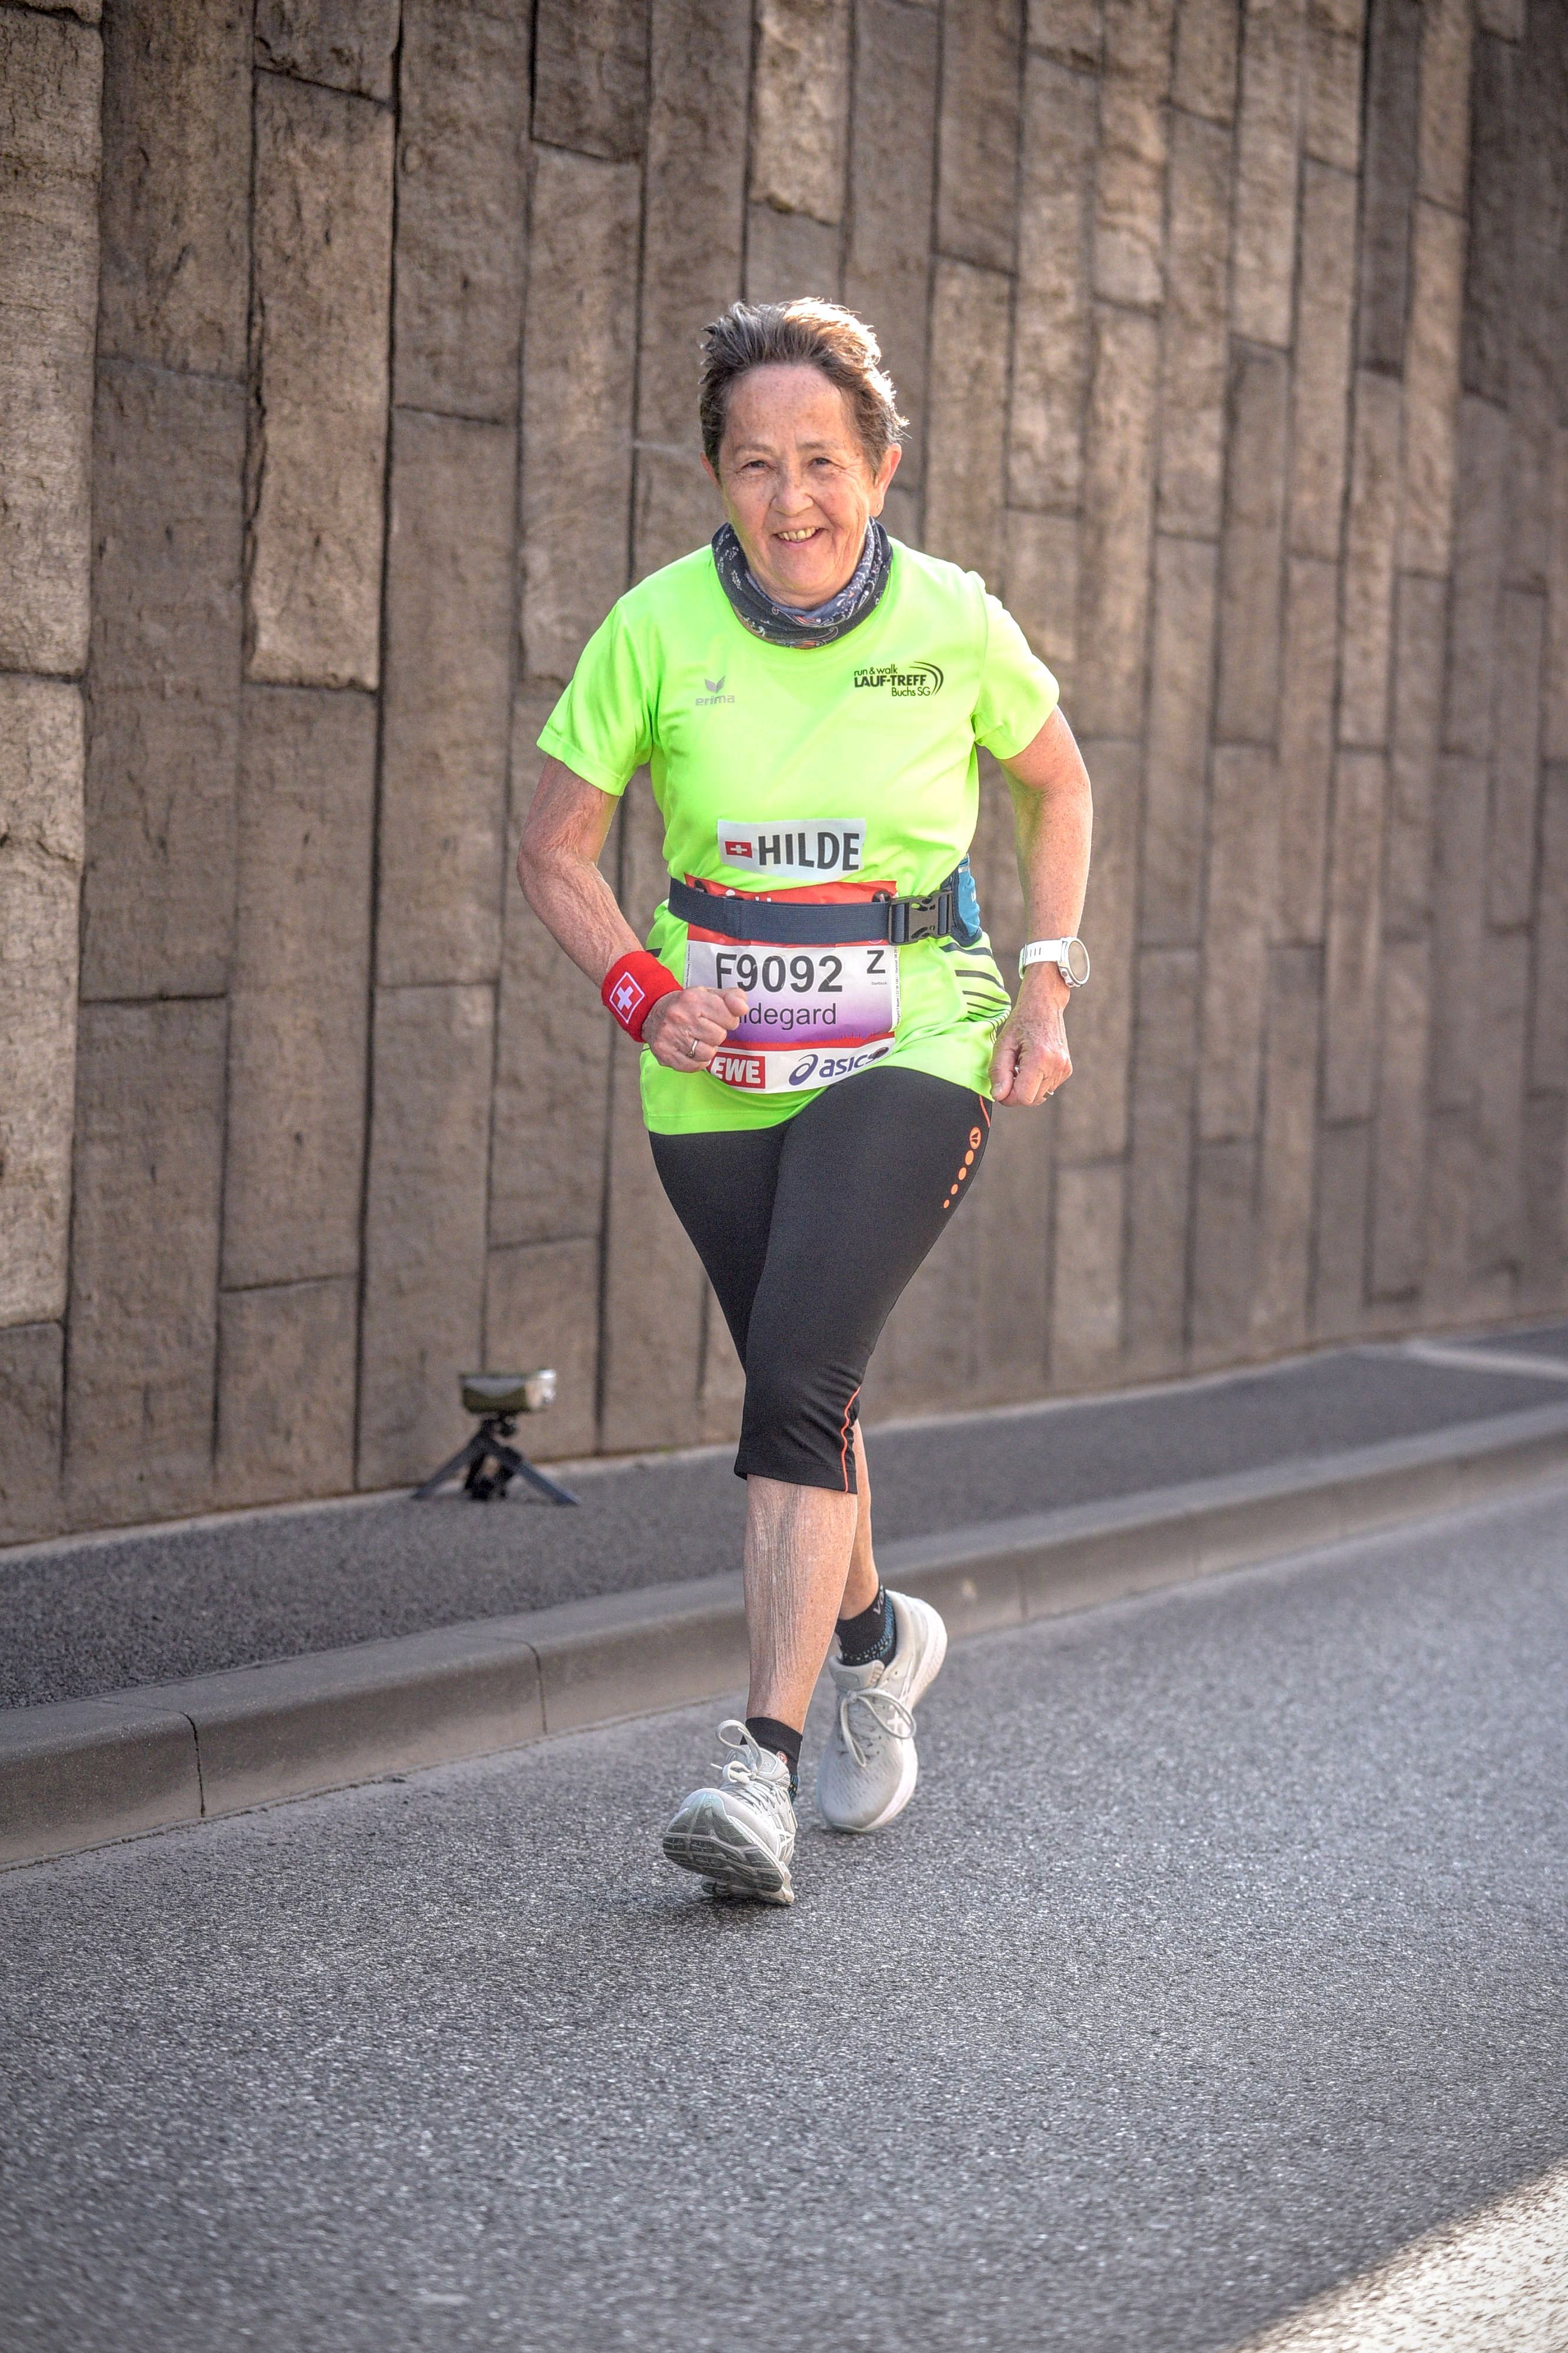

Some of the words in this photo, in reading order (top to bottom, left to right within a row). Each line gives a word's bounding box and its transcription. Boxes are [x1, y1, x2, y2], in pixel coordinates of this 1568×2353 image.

[854, 674, 927, 688] LAUF-TREFF
[876, 664, 898, 675] walk
[696, 695, 735, 706] erima
[892, 686, 916, 696] Buchs
[917, 686, 931, 696] SG
[758, 832, 860, 871] HILDE
[716, 952, 843, 993] F9092
[867, 949, 886, 974] Z
[739, 1002, 836, 1031] degard
[710, 1056, 761, 1084] EWE
